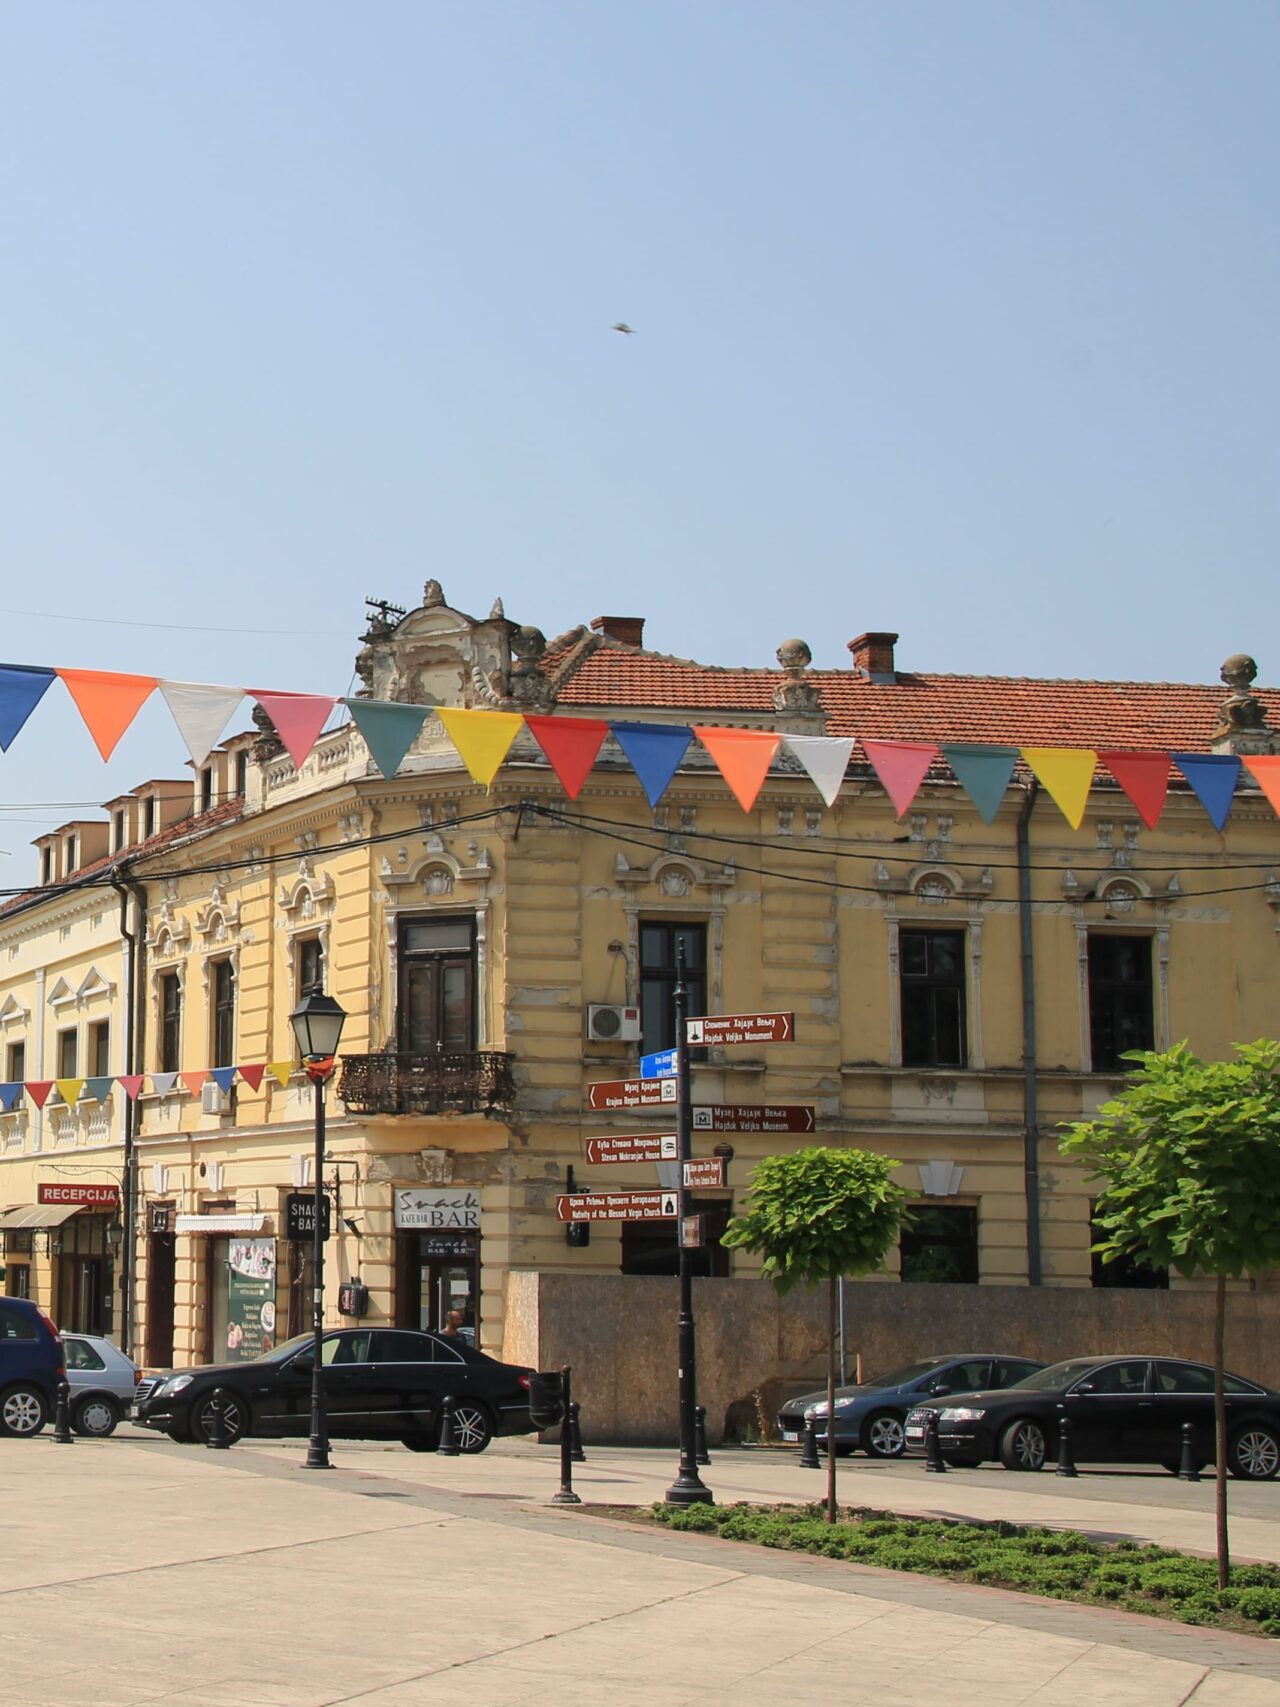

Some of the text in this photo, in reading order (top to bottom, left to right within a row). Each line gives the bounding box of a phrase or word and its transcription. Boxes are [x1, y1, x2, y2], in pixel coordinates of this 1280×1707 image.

[704, 1031, 773, 1044] Hajduk Veljko Monument
[606, 1094, 660, 1107] Krajina Region Museum
[714, 1108, 734, 1118] Музеј
[738, 1108, 761, 1118] Хајдук
[714, 1122, 789, 1132] Hajduk Veljko Museum
[601, 1153, 618, 1162] Stevan
[645, 1150, 660, 1160] House
[43, 1188, 116, 1201] RECEPCIJA
[400, 1192, 480, 1210] Snack
[430, 1210, 478, 1227] BAR
[572, 1206, 661, 1220] Nativity of the Blessed Virgin Church
